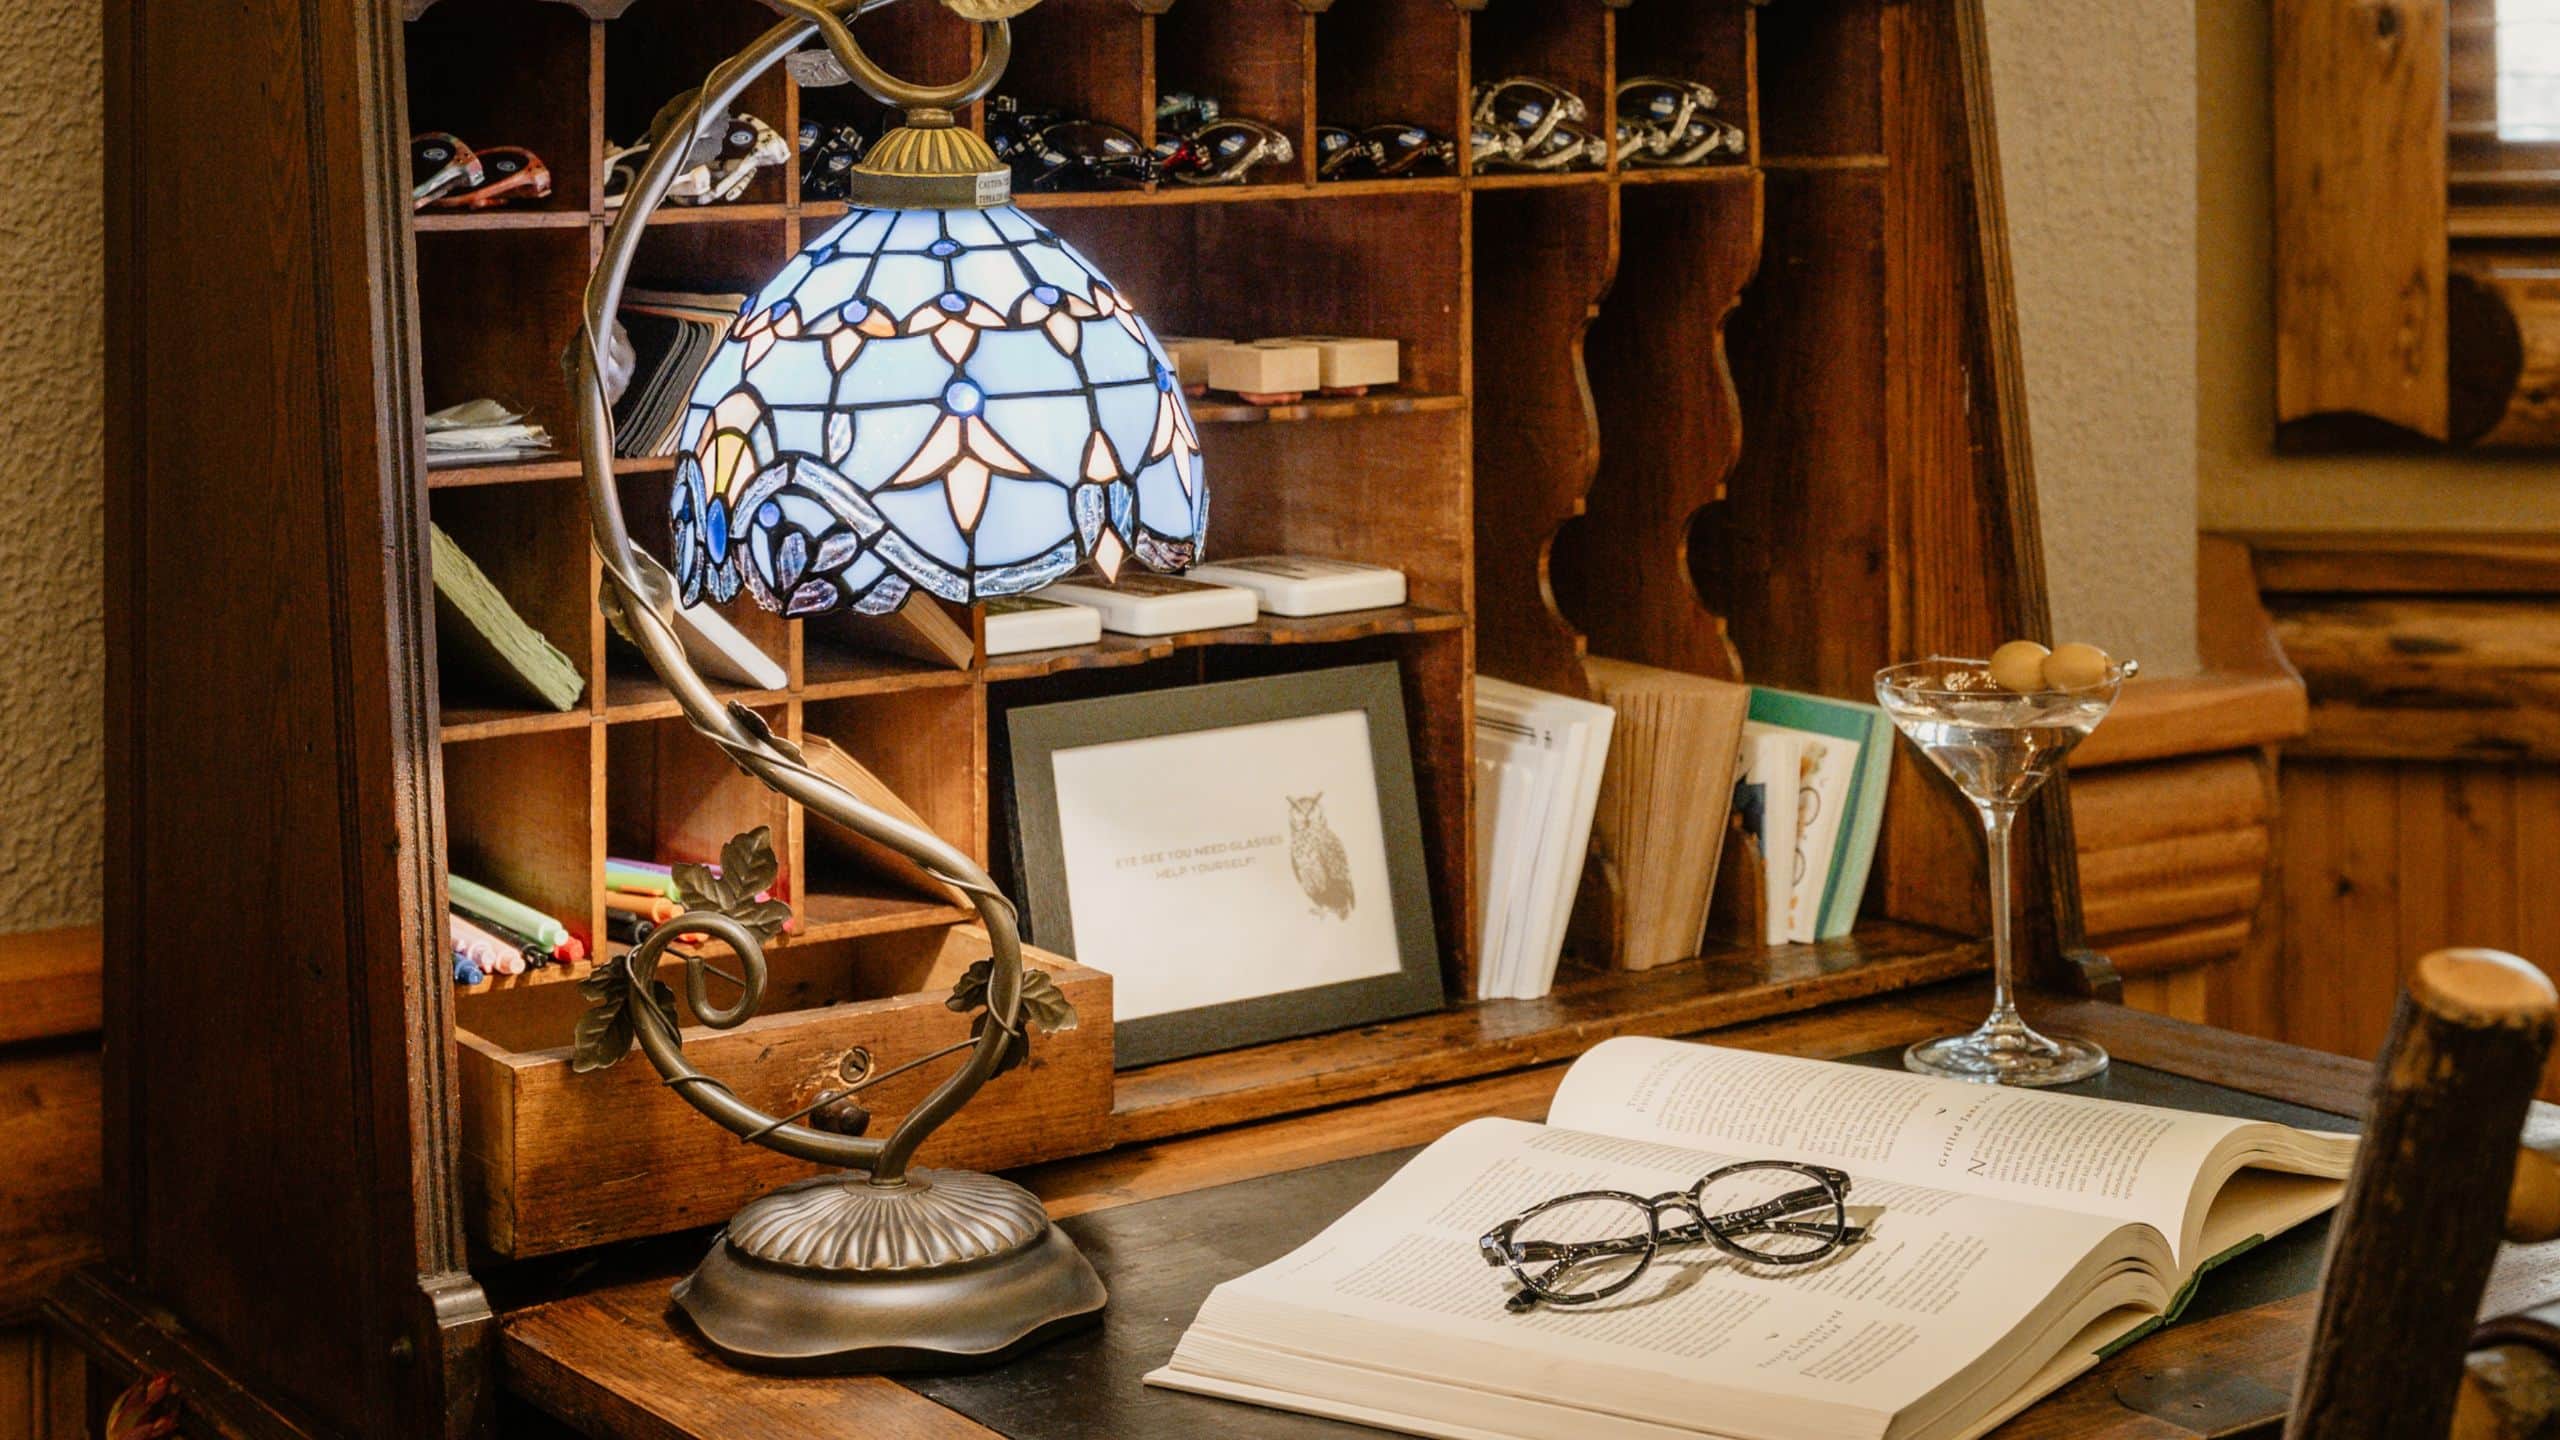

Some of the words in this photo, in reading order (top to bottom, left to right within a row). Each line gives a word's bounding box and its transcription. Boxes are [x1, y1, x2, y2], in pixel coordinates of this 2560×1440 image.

[1142, 853, 1164, 865] SEE
[1168, 848, 1192, 859] YOU
[1194, 843, 1226, 856] NEED
[1229, 835, 1284, 850] GLASSES
[1155, 866, 1187, 880] HELP
[1938, 1122, 1964, 1168] Grilled
